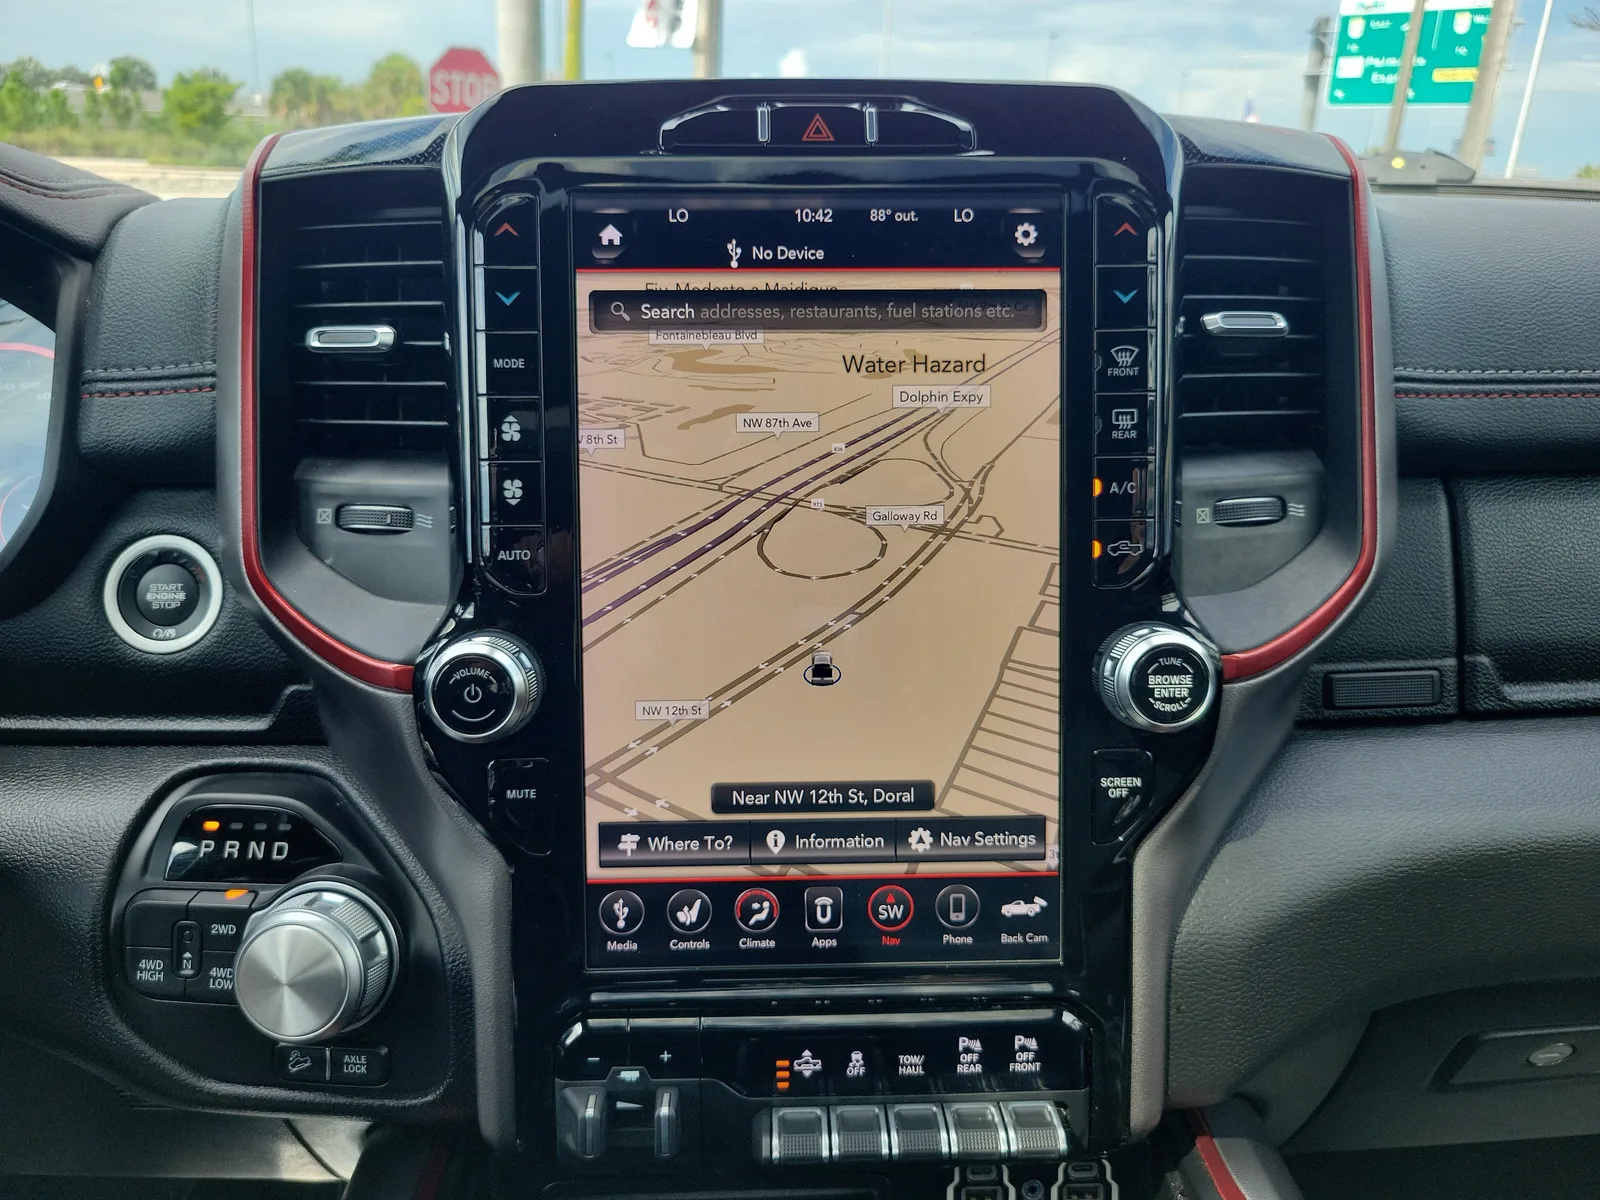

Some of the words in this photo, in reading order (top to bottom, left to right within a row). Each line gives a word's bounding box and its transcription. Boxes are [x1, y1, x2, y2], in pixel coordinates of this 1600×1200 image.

[432, 70, 498, 106] STOP
[668, 208, 689, 223] LO
[795, 208, 833, 223] 10:42
[870, 208, 892, 222] 88°
[894, 210, 919, 222] out.
[954, 208, 975, 223] LO
[752, 246, 773, 260] No
[776, 246, 825, 260] Device
[641, 303, 695, 319] Search
[700, 303, 785, 321] addresses,
[790, 304, 882, 321] restaurants,
[887, 302, 916, 318] fuel
[922, 303, 981, 319] stations
[986, 305, 1015, 318] etc.
[656, 330, 732, 341] Fontainebleau
[735, 330, 758, 341] Blvd
[493, 358, 525, 369] MODE
[842, 354, 906, 373] Water
[913, 353, 986, 373] Hazard
[1107, 366, 1140, 377] FRONT
[900, 390, 948, 404] Dolphin
[953, 390, 984, 405] Expy
[743, 418, 762, 428] NW
[765, 418, 790, 428] 87th
[792, 418, 812, 428] Ave
[586, 433, 604, 445] 8th
[607, 433, 618, 445] St
[1111, 430, 1137, 439] REAR
[1110, 481, 1137, 494] A/C
[872, 510, 921, 523] Galloway
[923, 511, 938, 521] Rd
[497, 550, 531, 561] AUTO
[149, 583, 184, 591] START
[146, 592, 187, 600] ENGINE
[152, 601, 181, 609] STOP
[1158, 656, 1183, 667] TUNE
[453, 667, 491, 680] VOLUME
[1148, 674, 1193, 685] BROWSE
[1154, 688, 1189, 698] ENTER
[642, 706, 662, 716] NW
[665, 706, 688, 716] 12th
[691, 706, 702, 715] St
[1153, 700, 1188, 712] SCROLL
[1100, 777, 1142, 788] SCREEN
[506, 789, 537, 799] MUTE
[732, 790, 770, 805] Near
[774, 790, 804, 805] NW
[809, 789, 843, 804] 12th
[848, 789, 868, 805] St,
[873, 788, 915, 803] Doral
[1108, 788, 1129, 798] OFF
[648, 836, 700, 850] Where
[703, 836, 734, 850] To?
[795, 833, 884, 849] Information
[940, 832, 971, 847] Nav
[974, 831, 1036, 849] Settings
[200, 839, 215, 858] P
[223, 840, 240, 859] R
[247, 841, 266, 860] N
[271, 841, 289, 861] D
[878, 904, 904, 920] SW
[211, 924, 236, 935] 2WD
[669, 938, 710, 949] Controls
[739, 937, 776, 948] Climate
[811, 936, 838, 949] Apps
[881, 935, 901, 945] Nav
[942, 934, 973, 945] Phone
[1000, 933, 1023, 944] Back
[1025, 932, 1049, 943] Cam
[606, 940, 638, 951] Media
[138, 959, 164, 970] 4WD
[182, 960, 192, 970] N
[137, 971, 164, 982] HIGH
[209, 967, 234, 978] 4WD
[209, 979, 234, 990] LOW
[343, 1054, 367, 1064] AXLE
[898, 1055, 925, 1065] TOW/
[959, 1053, 980, 1063] OFF
[1015, 1051, 1036, 1062] OFF
[343, 1064, 367, 1074] LOCK
[846, 1066, 866, 1076] OFF
[898, 1065, 925, 1075] HAUL
[956, 1063, 983, 1074] REAR
[1009, 1062, 1042, 1073] FRONT
